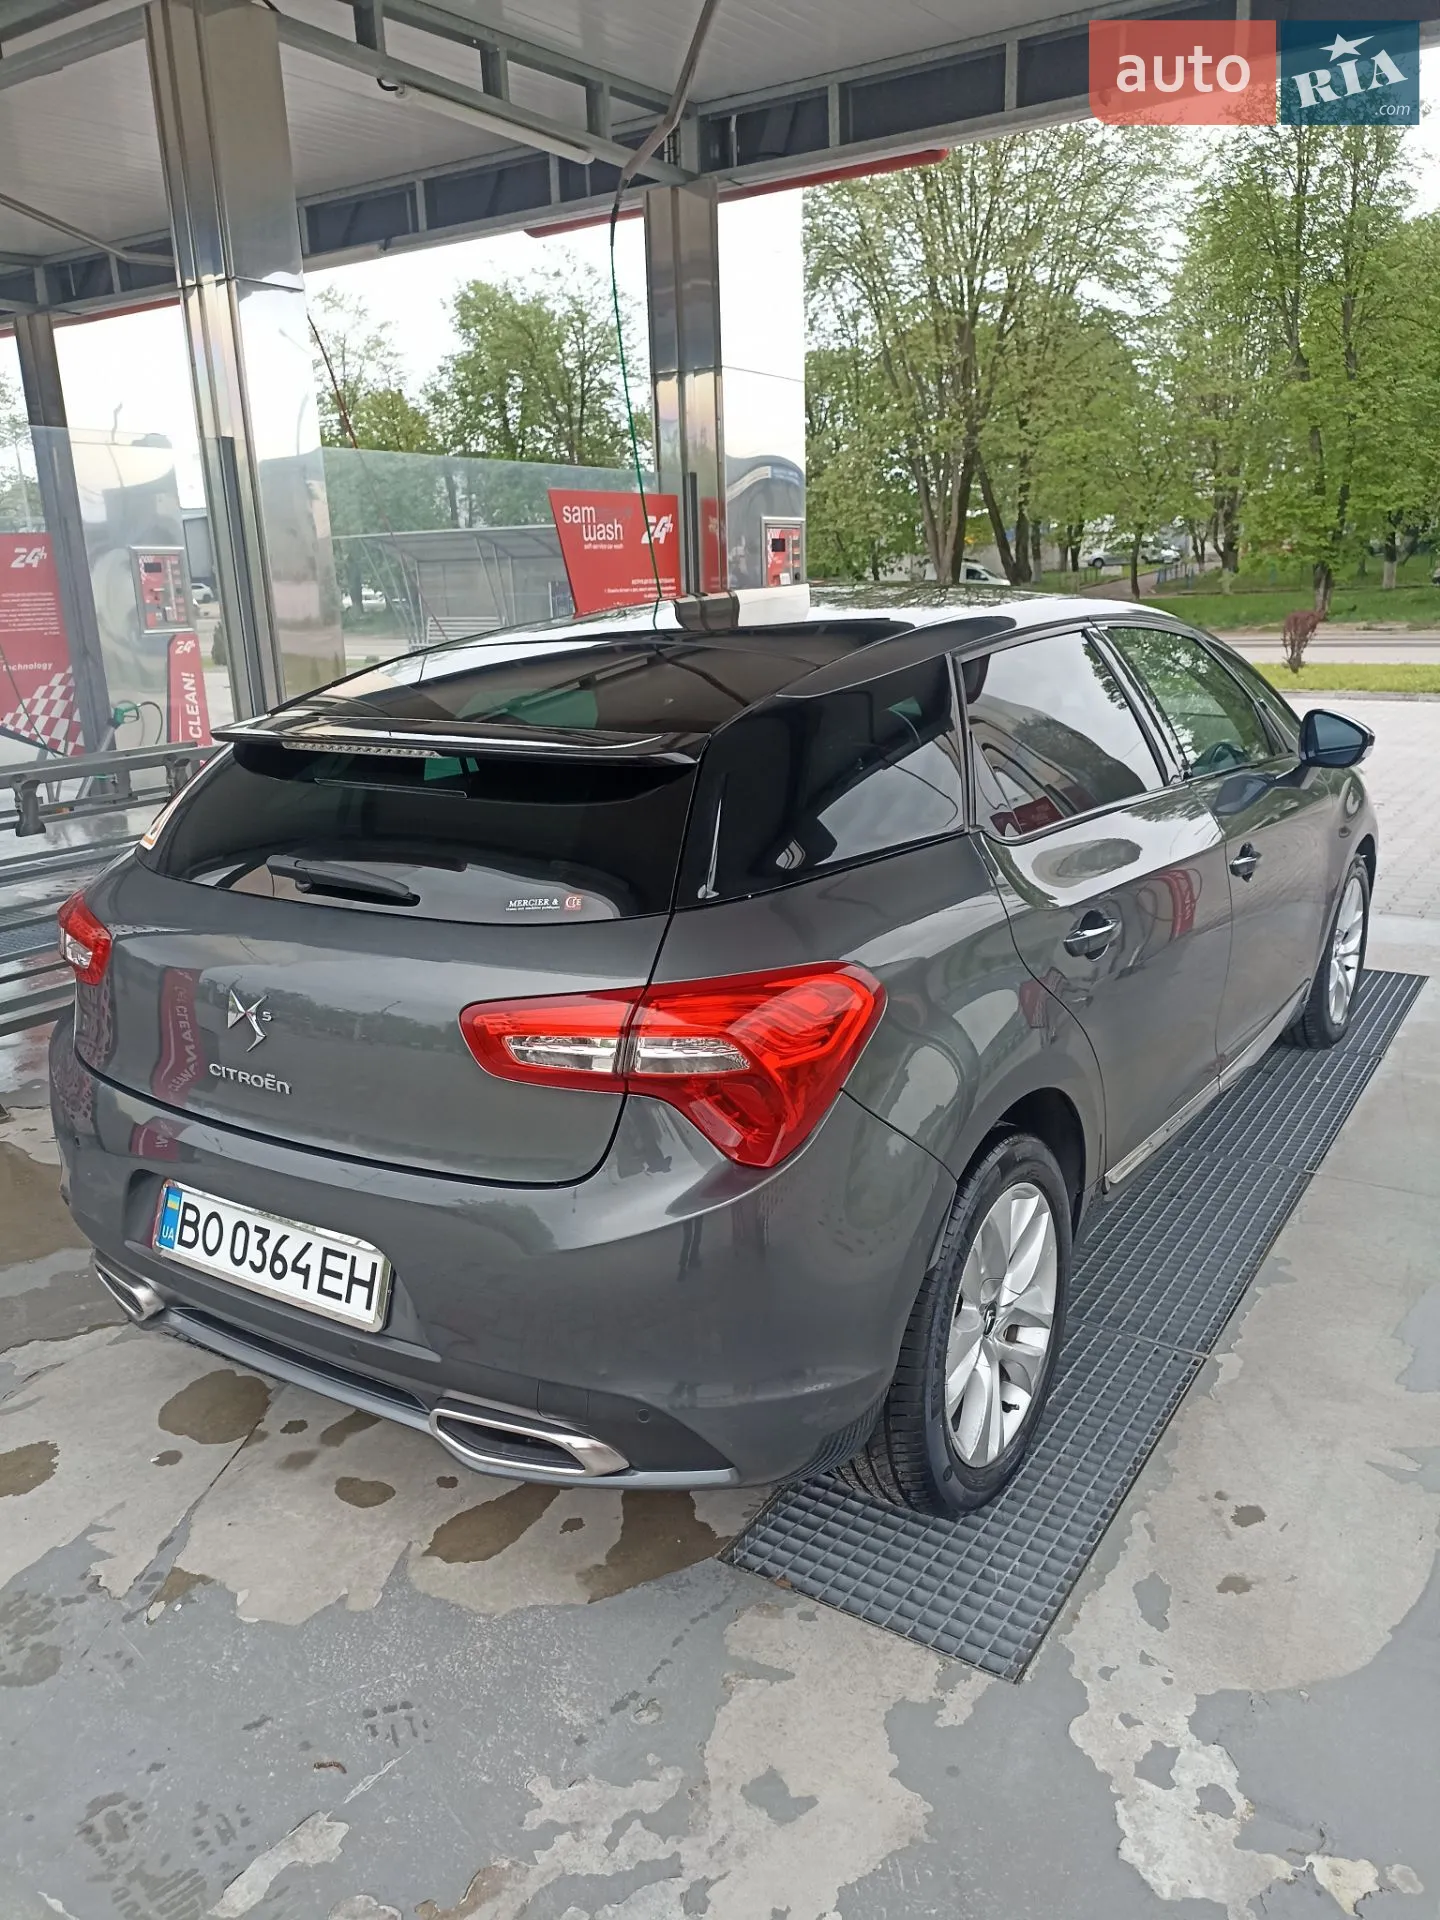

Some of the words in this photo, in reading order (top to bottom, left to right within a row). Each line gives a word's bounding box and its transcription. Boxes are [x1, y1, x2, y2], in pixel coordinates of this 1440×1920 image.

[563, 505, 596, 523] sam
[582, 519, 623, 541] wash
[181, 672, 202, 739] CLEAN!
[509, 899, 548, 908] MERCIER
[552, 898, 559, 906] &
[162, 1224, 174, 1241] UA
